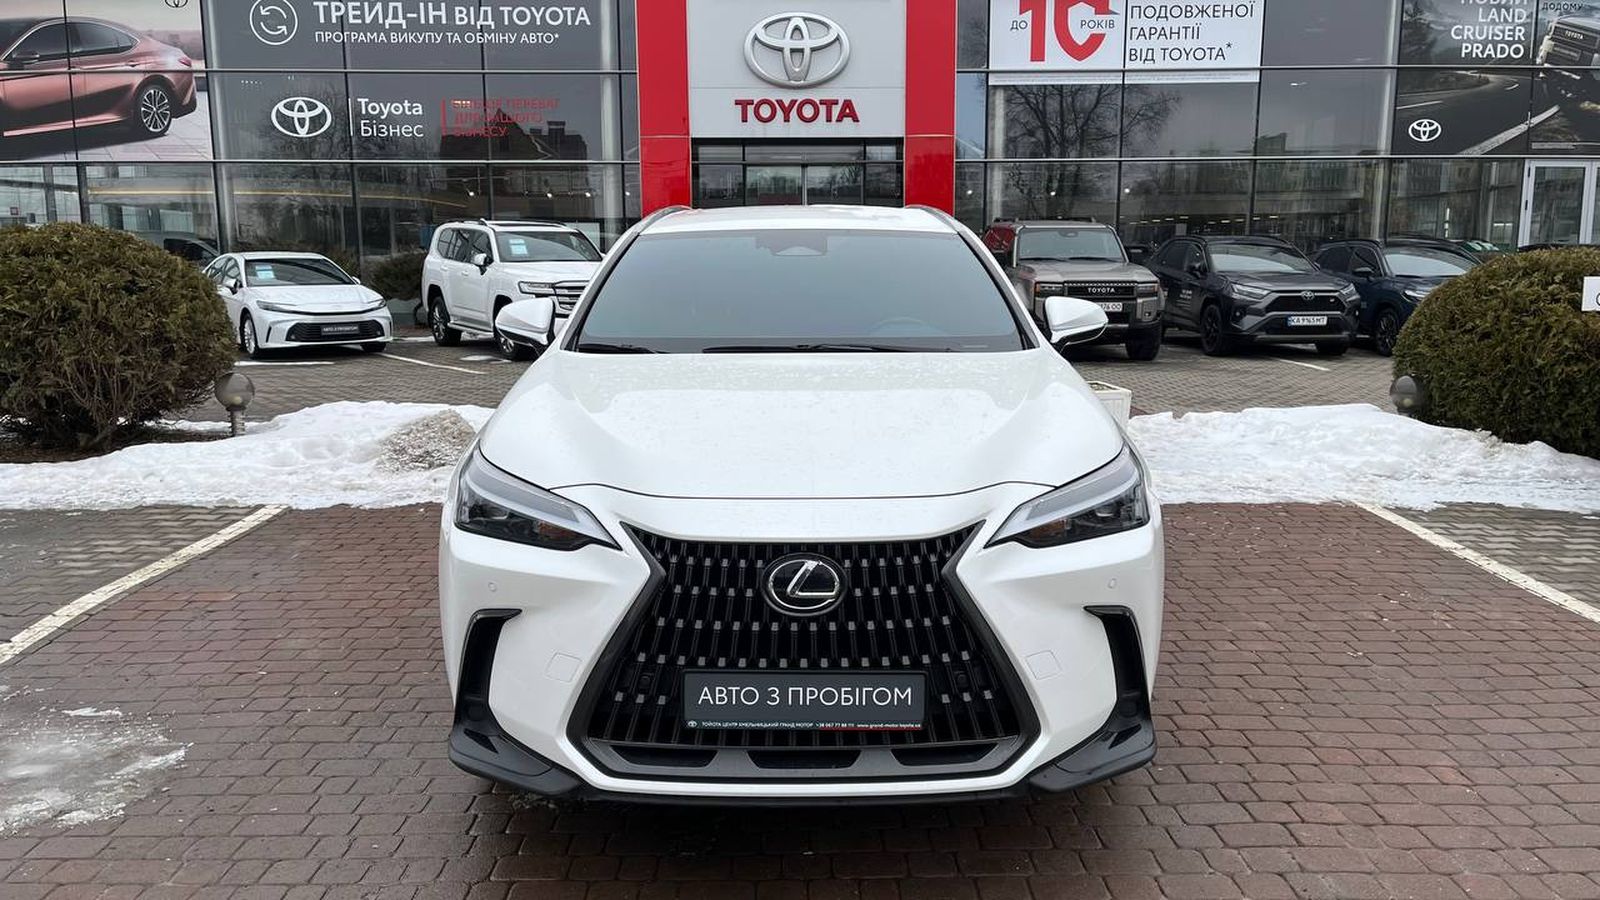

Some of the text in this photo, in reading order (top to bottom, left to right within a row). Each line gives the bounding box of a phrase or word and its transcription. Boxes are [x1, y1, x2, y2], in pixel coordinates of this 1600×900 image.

[313, 0, 591, 30] ТРЕЙД-ІН ВІД TOYOTA
[1130, 0, 1256, 21] ПОДОВЖЕНОЇ
[1478, 7, 1527, 23] LAND
[1010, 20, 1028, 31] ДО
[1080, 19, 1115, 29] РОКІВ
[1129, 22, 1202, 41] ГАРАНТІЇ
[315, 31, 387, 43] ПРОГРАМА
[390, 32, 443, 43] ВИКУПУ
[446, 32, 461, 44] ТА
[464, 32, 517, 44] ОБМІНУ
[1451, 25, 1526, 41] CRUISER
[1129, 48, 1155, 64] ВІД
[1460, 43, 1525, 59] PRADO
[357, 98, 423, 119] Toyota
[734, 98, 860, 123] TOYOTA
[360, 120, 424, 137] Бізнес
[698, 686, 913, 706] АВТО З ПРОБІГОМ
